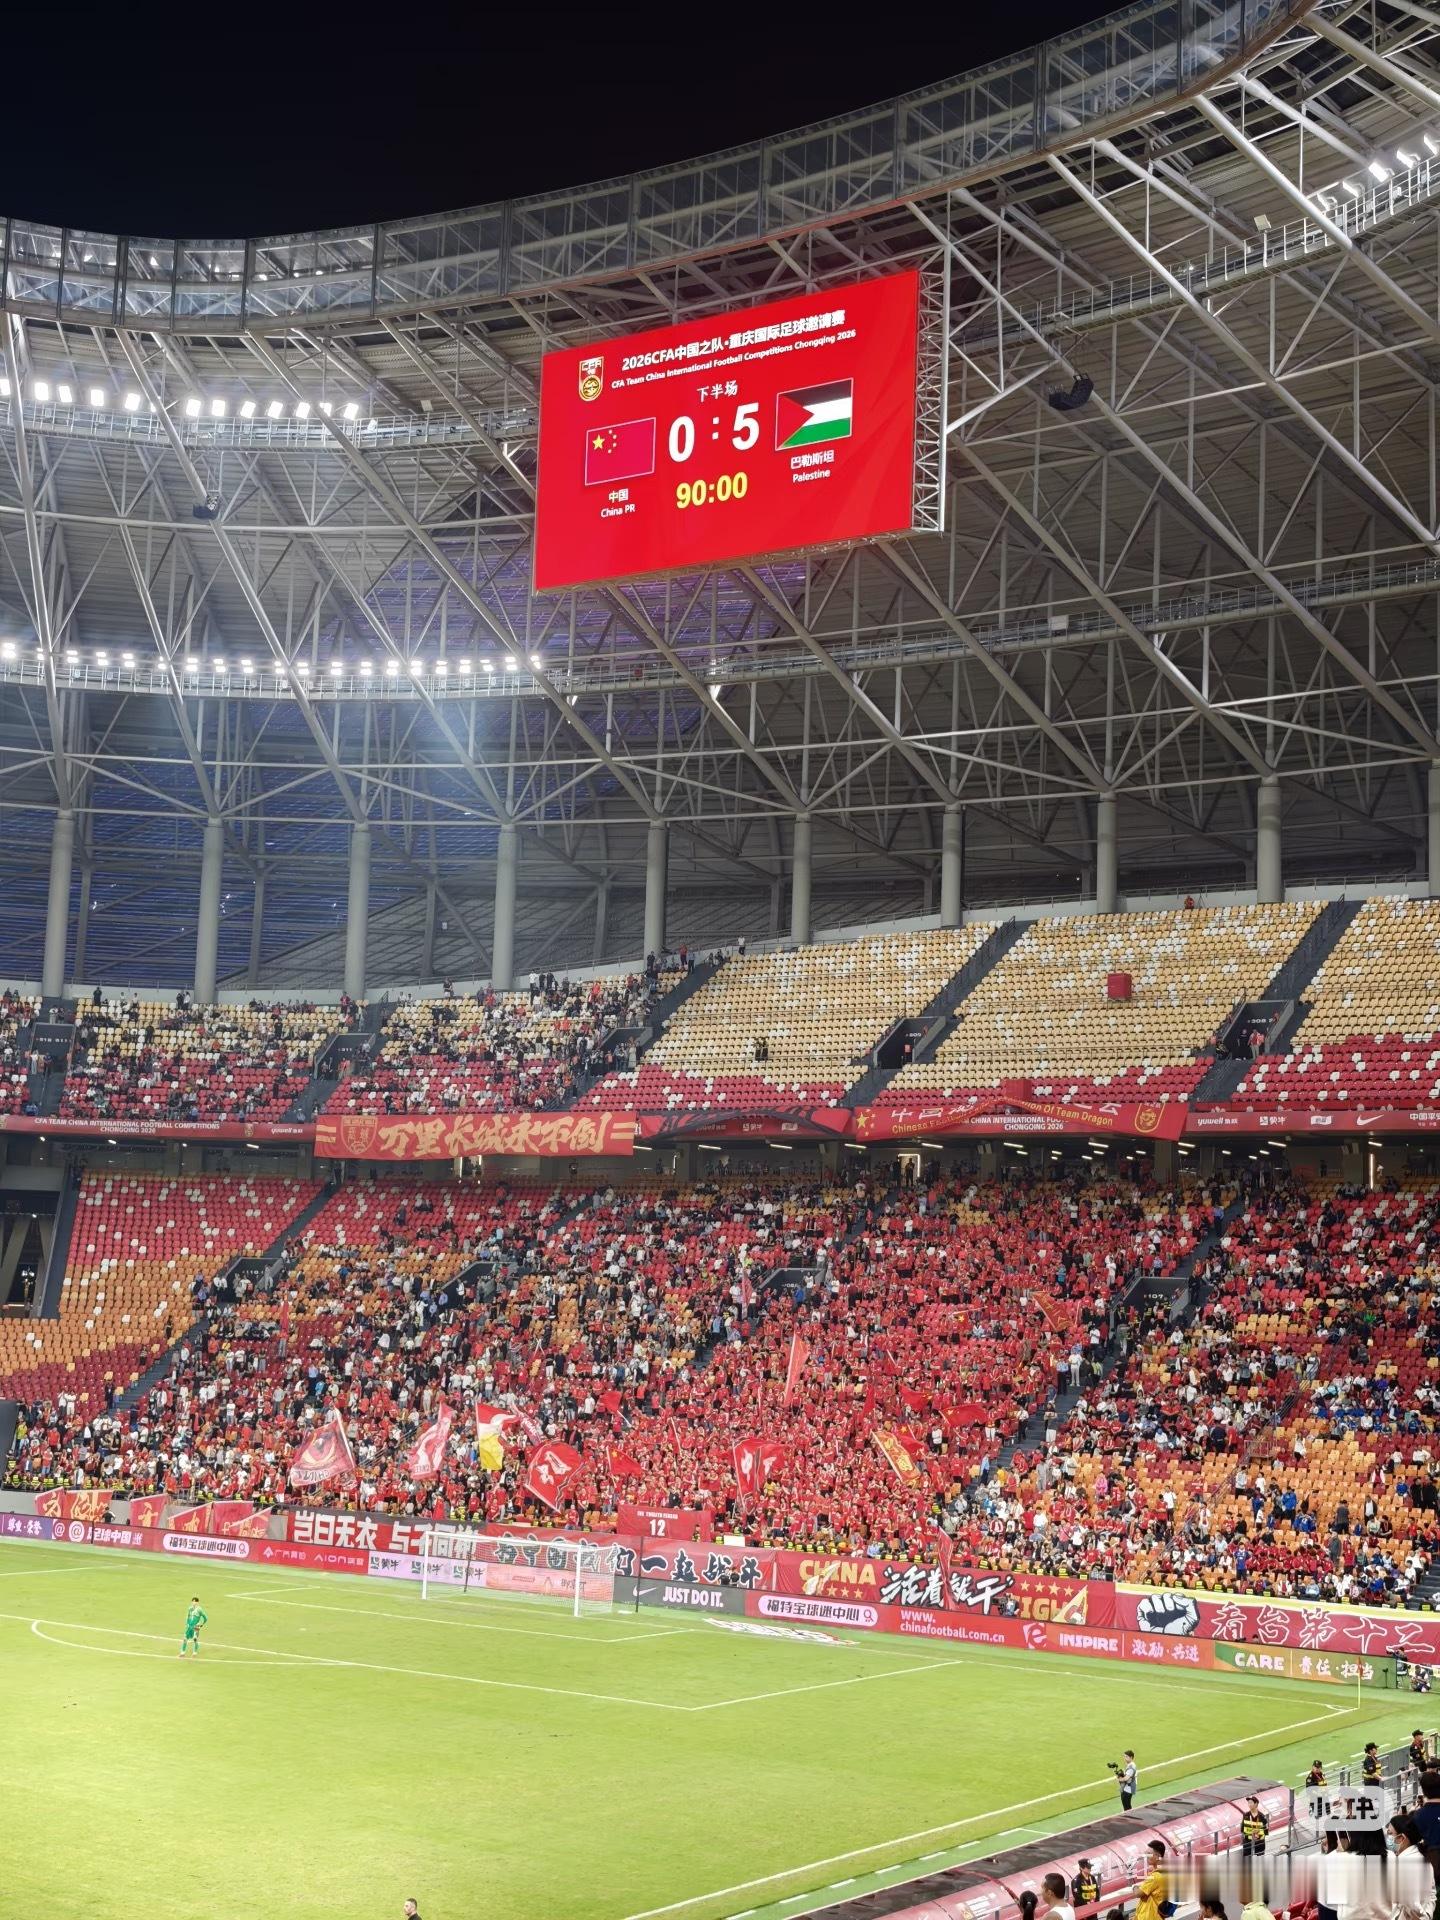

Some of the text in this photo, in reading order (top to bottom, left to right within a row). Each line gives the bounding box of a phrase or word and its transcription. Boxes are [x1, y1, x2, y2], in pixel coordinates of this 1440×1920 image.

[622, 309, 846, 371] 2026CFA中国之队·重庆国际足球邀请赛
[611, 329, 856, 389] CFA Team China International Football Competitions Chongqing 2026
[696, 380, 738, 403] 下半场
[668, 415, 695, 463] 0
[731, 402, 760, 451] 5
[790, 449, 835, 470] 巴勒斯坦
[792, 468, 831, 484] Palestine
[608, 488, 629, 503] 中国
[676, 471, 748, 509] 90:00
[600, 503, 636, 519] China PR
[35, 1118, 48, 1126] CFA
[90, 1120, 139, 1128] INTERNATIONAL
[140, 1121, 172, 1129] FOOTBALL
[174, 1122, 220, 1130] COMPETITIONS
[971, 1116, 992, 1124] CHINA
[993, 1116, 1045, 1124] INTERNATIONAL
[1043, 1104, 1054, 1113] Of
[1056, 1106, 1080, 1120] Team
[1081, 1111, 1114, 1127] Dragon
[1197, 1116, 1223, 1127] yuwell
[377, 1112, 613, 1156] 万里长城永不倒
[892, 1121, 928, 1134] Chinese
[649, 1518, 666, 1537] 12
[663, 1586, 724, 1608] JUST DO IT.
[766, 1599, 860, 1622] 福特宝球迷中心
[900, 1610, 936, 1624] www.
[900, 1621, 1005, 1643] chinafootball.com.cn
[1059, 1632, 1118, 1652] INSPIRE
[1234, 1652, 1284, 1671] CARE
